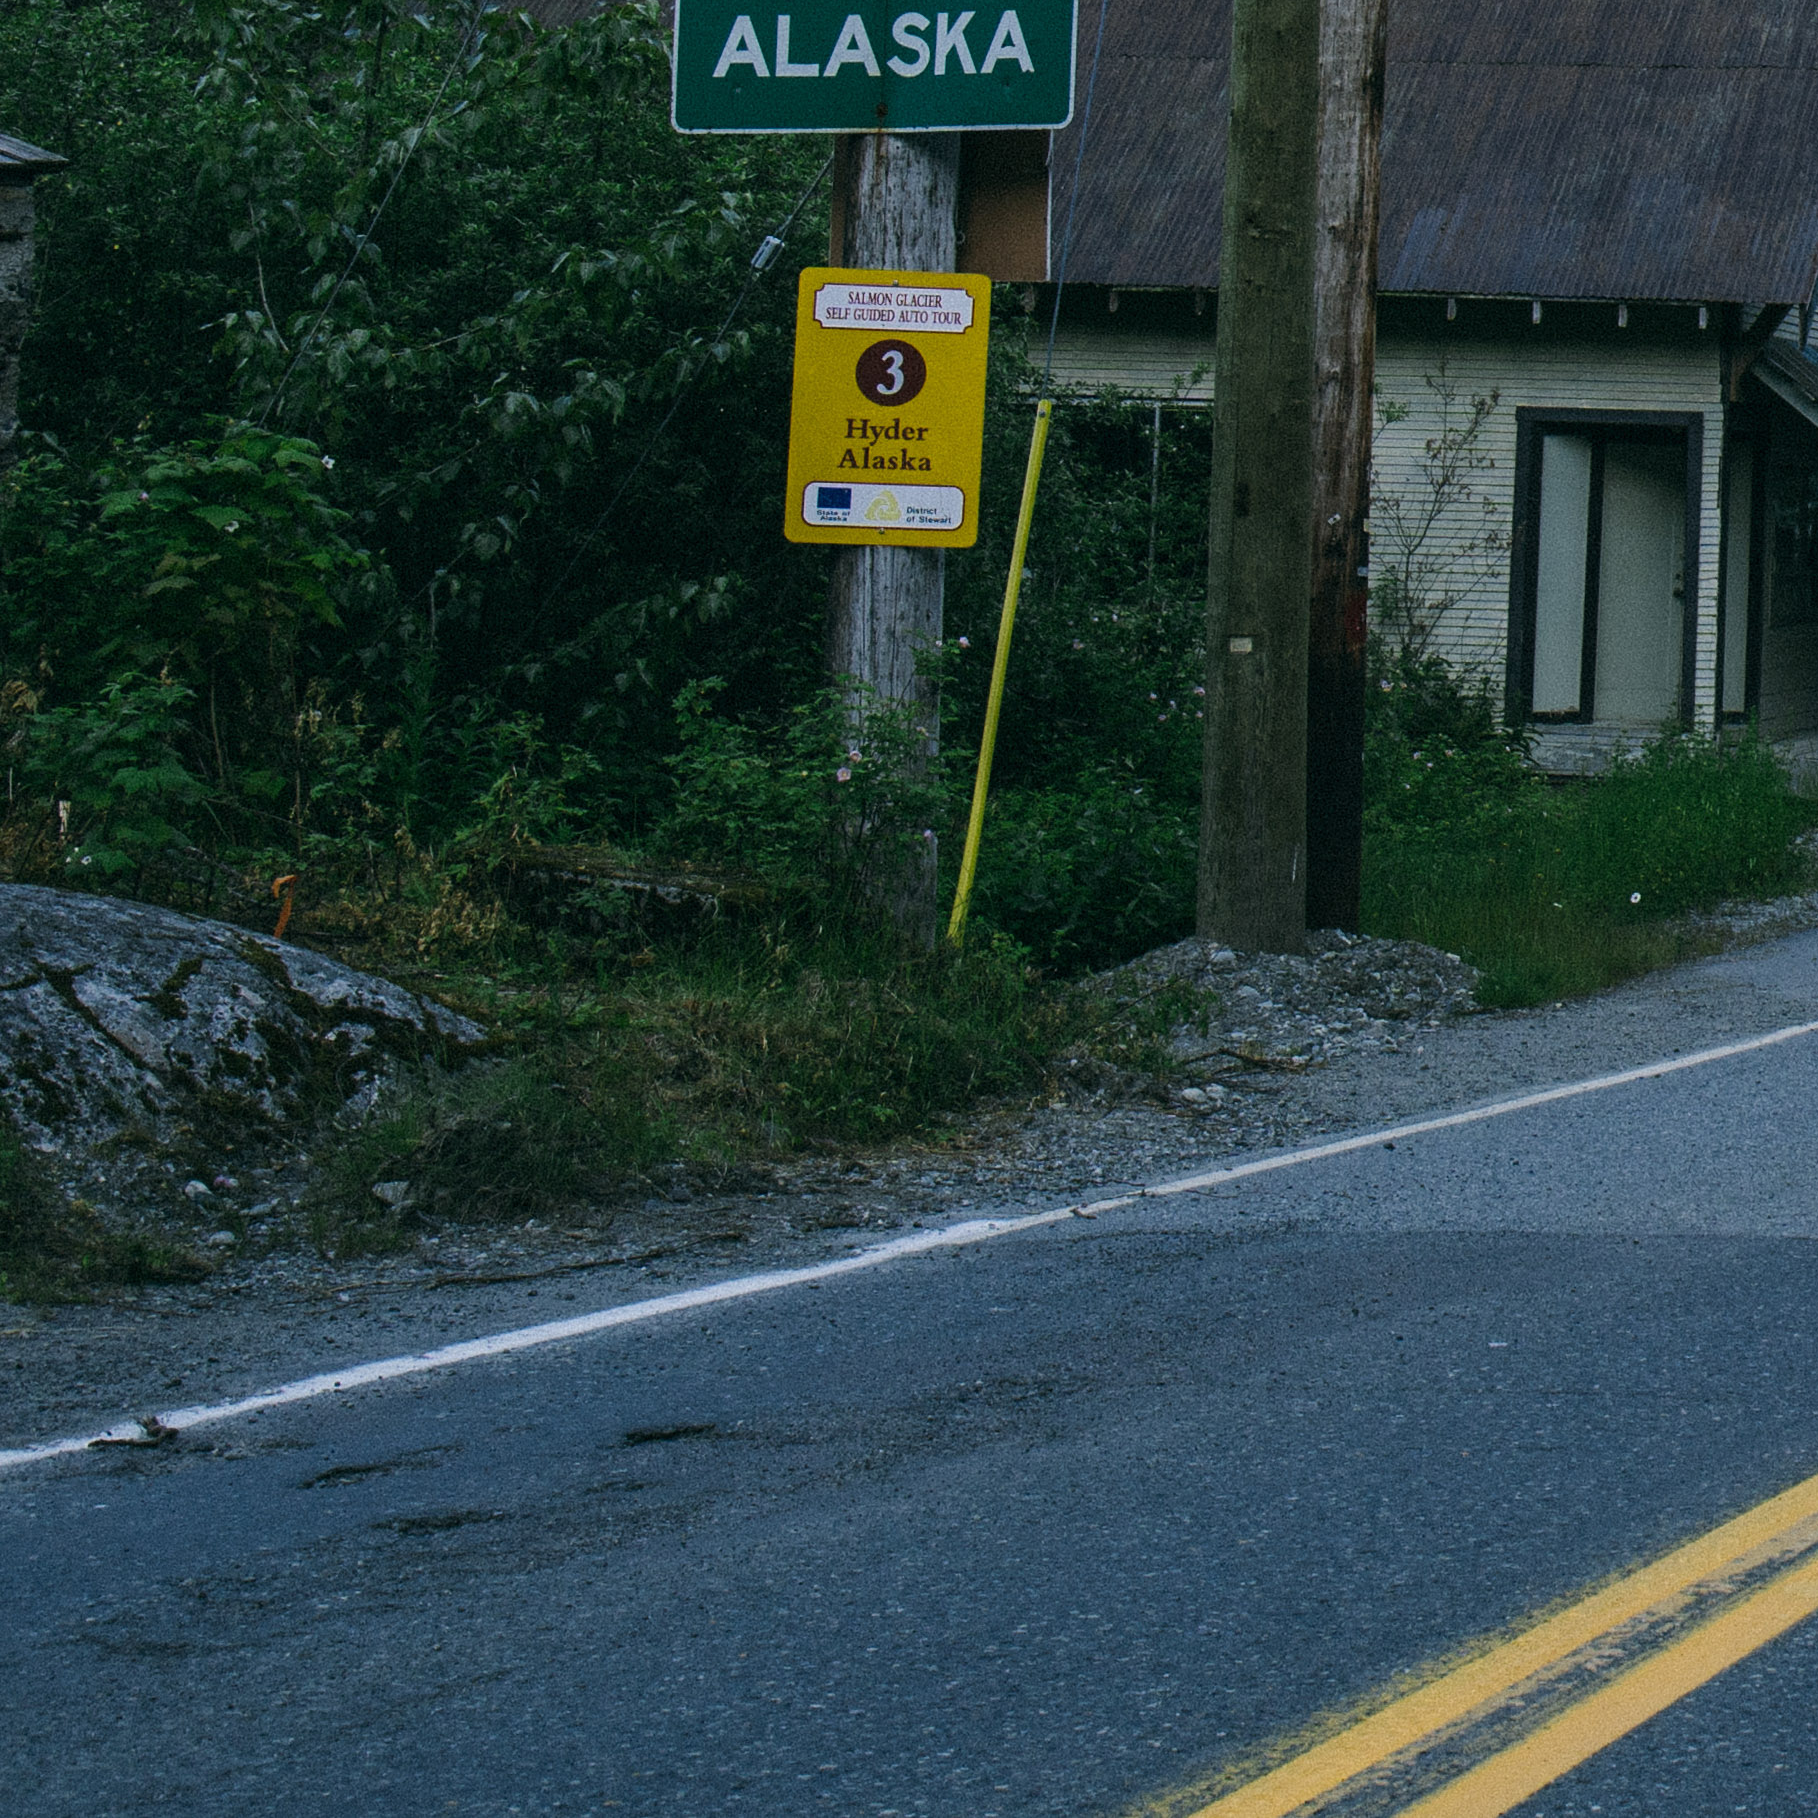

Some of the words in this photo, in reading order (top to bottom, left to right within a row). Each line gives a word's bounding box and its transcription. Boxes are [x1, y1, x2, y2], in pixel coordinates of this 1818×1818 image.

[712, 9, 1036, 78] ALASKA
[848, 291, 892, 306] SALMON
[896, 293, 942, 308] GLACIER
[825, 307, 850, 320] SELF
[853, 308, 895, 322] GUIDED
[898, 310, 928, 324] AUTO
[932, 312, 962, 325] TOUR
[876, 349, 905, 395] 3
[844, 417, 930, 446] Hyder
[836, 447, 932, 472] Alaska
[906, 506, 938, 515] District
[919, 516, 952, 524] Stewart
